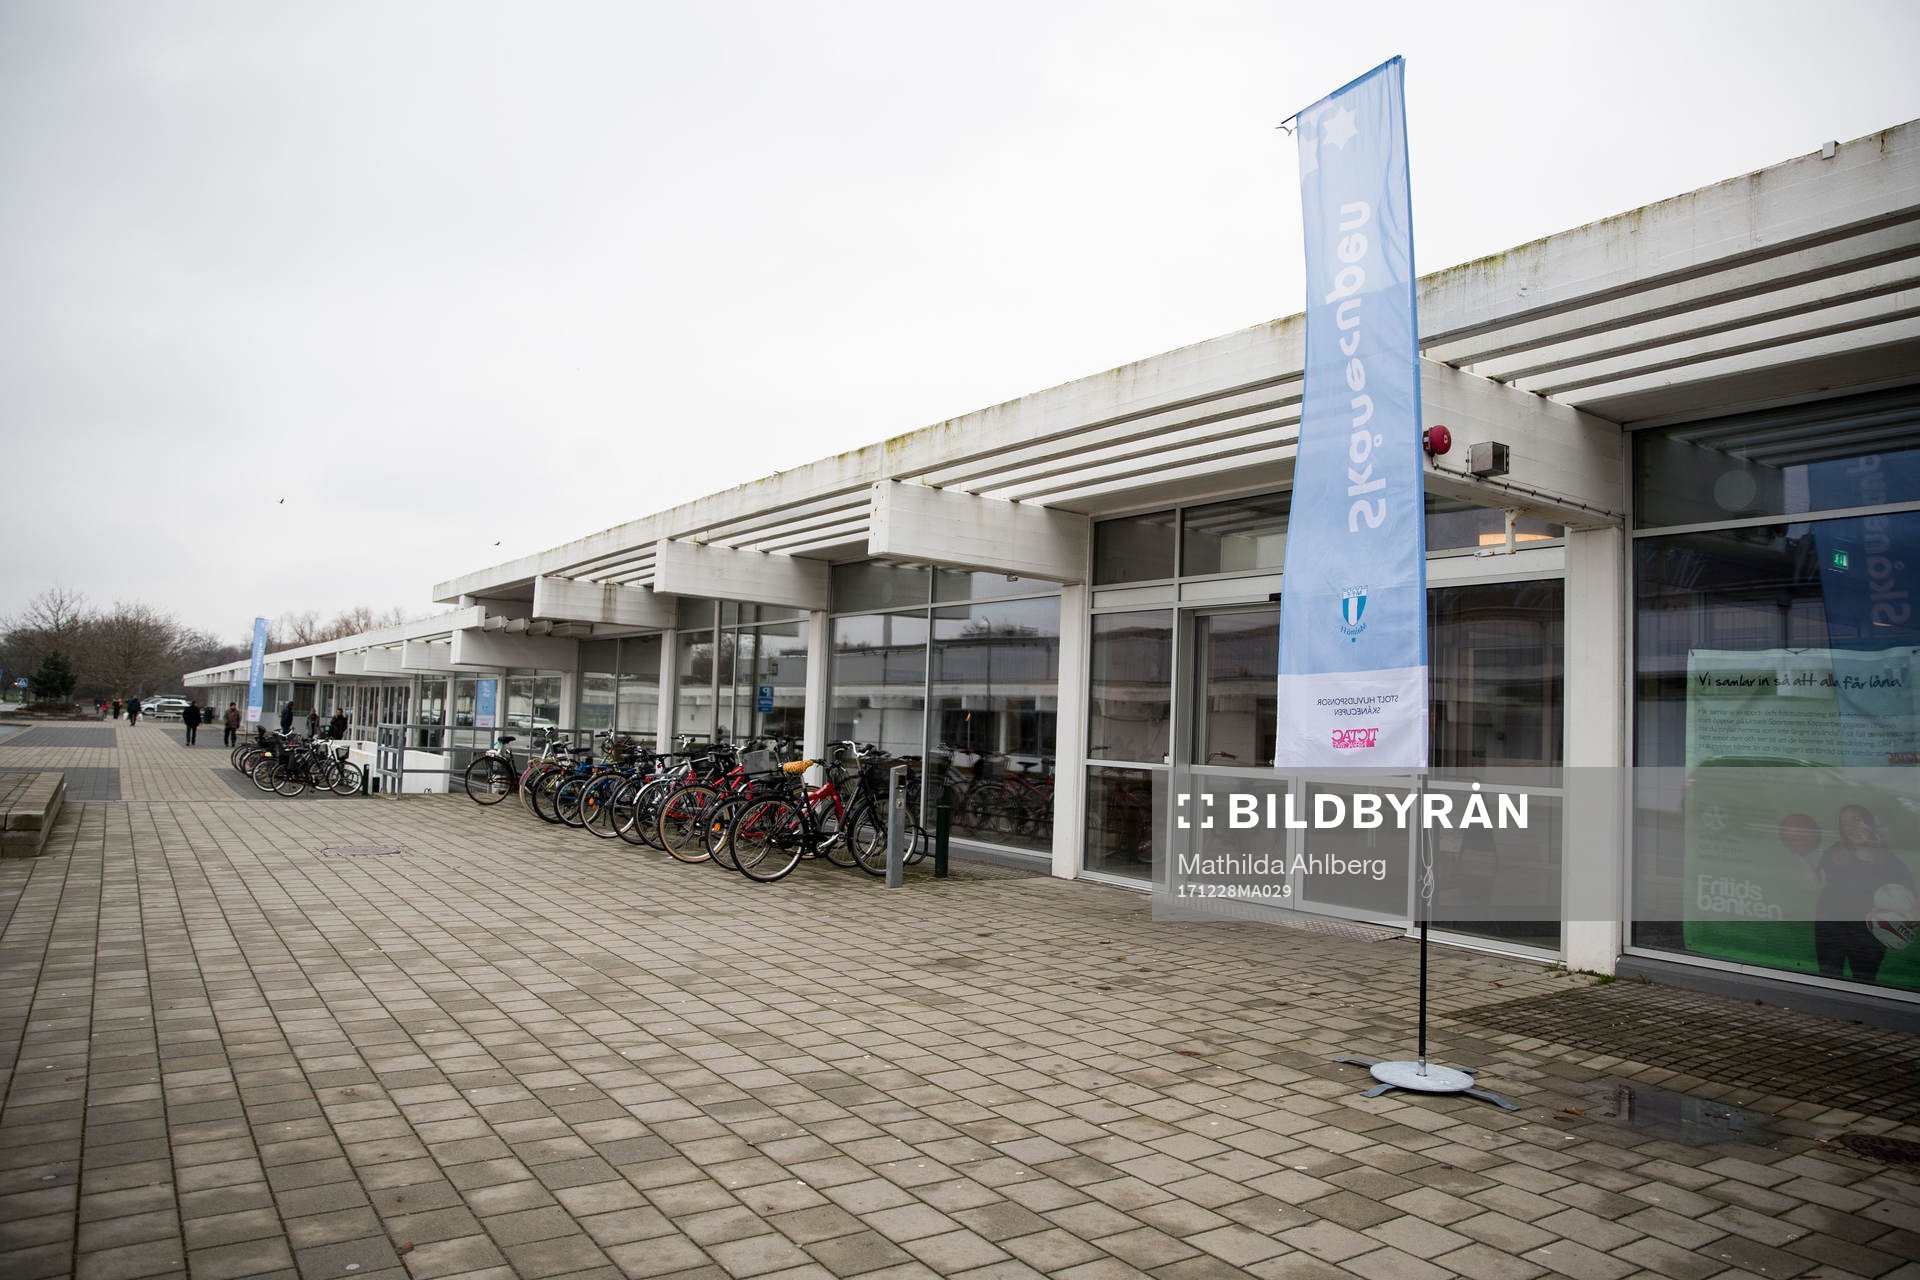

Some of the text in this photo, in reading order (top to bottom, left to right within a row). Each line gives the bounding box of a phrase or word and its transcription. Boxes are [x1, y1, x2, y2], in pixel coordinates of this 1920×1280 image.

[1698, 672, 1711, 687] Vi
[1715, 674, 1756, 687] samlar
[1758, 674, 1770, 686] in
[1774, 674, 1791, 687] så
[1793, 673, 1817, 687] att
[1819, 673, 1840, 688] alla
[1842, 675, 1869, 690] får
[1697, 873, 1763, 901] Fritids
[1697, 894, 1783, 921] banken
